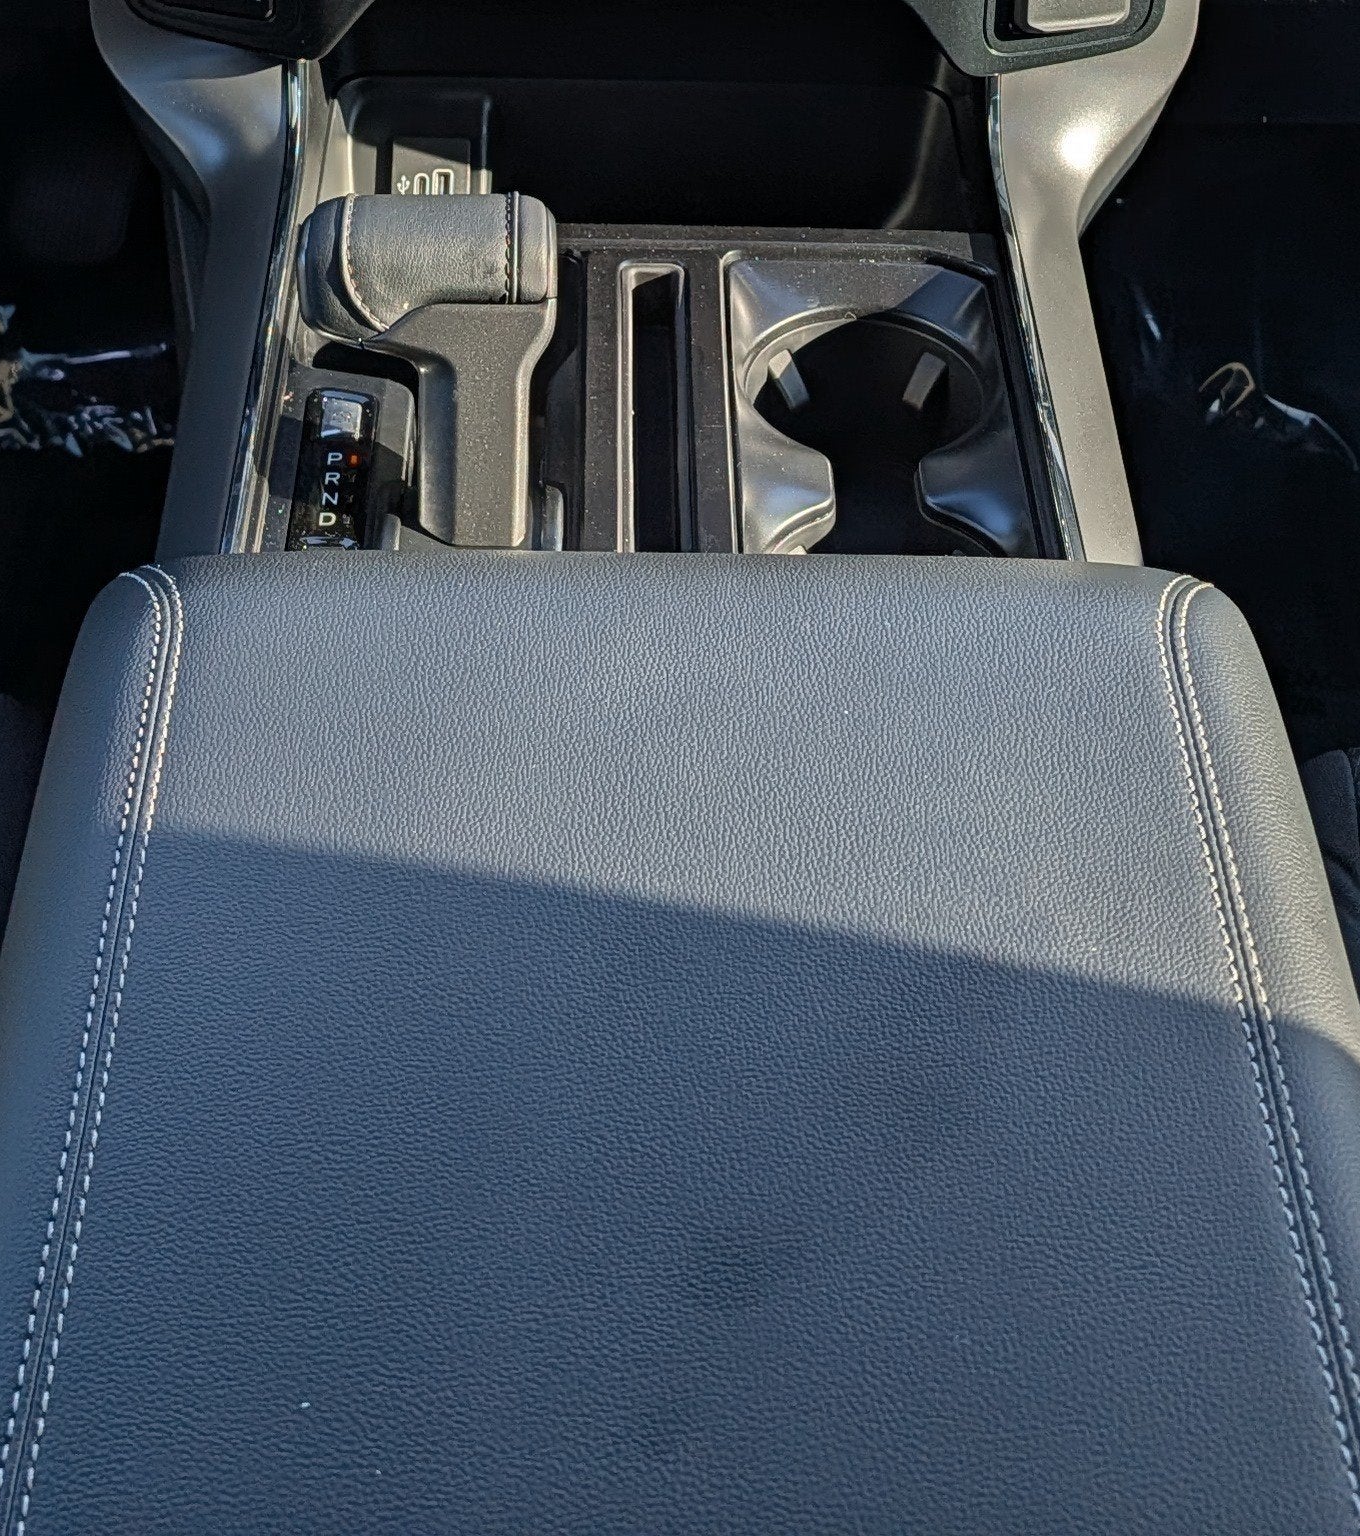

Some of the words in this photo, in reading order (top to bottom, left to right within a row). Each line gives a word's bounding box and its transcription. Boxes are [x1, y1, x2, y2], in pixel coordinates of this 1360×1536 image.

[327, 452, 342, 465] P
[324, 472, 340, 486] R
[322, 492, 339, 506] N
[319, 512, 337, 527] D
